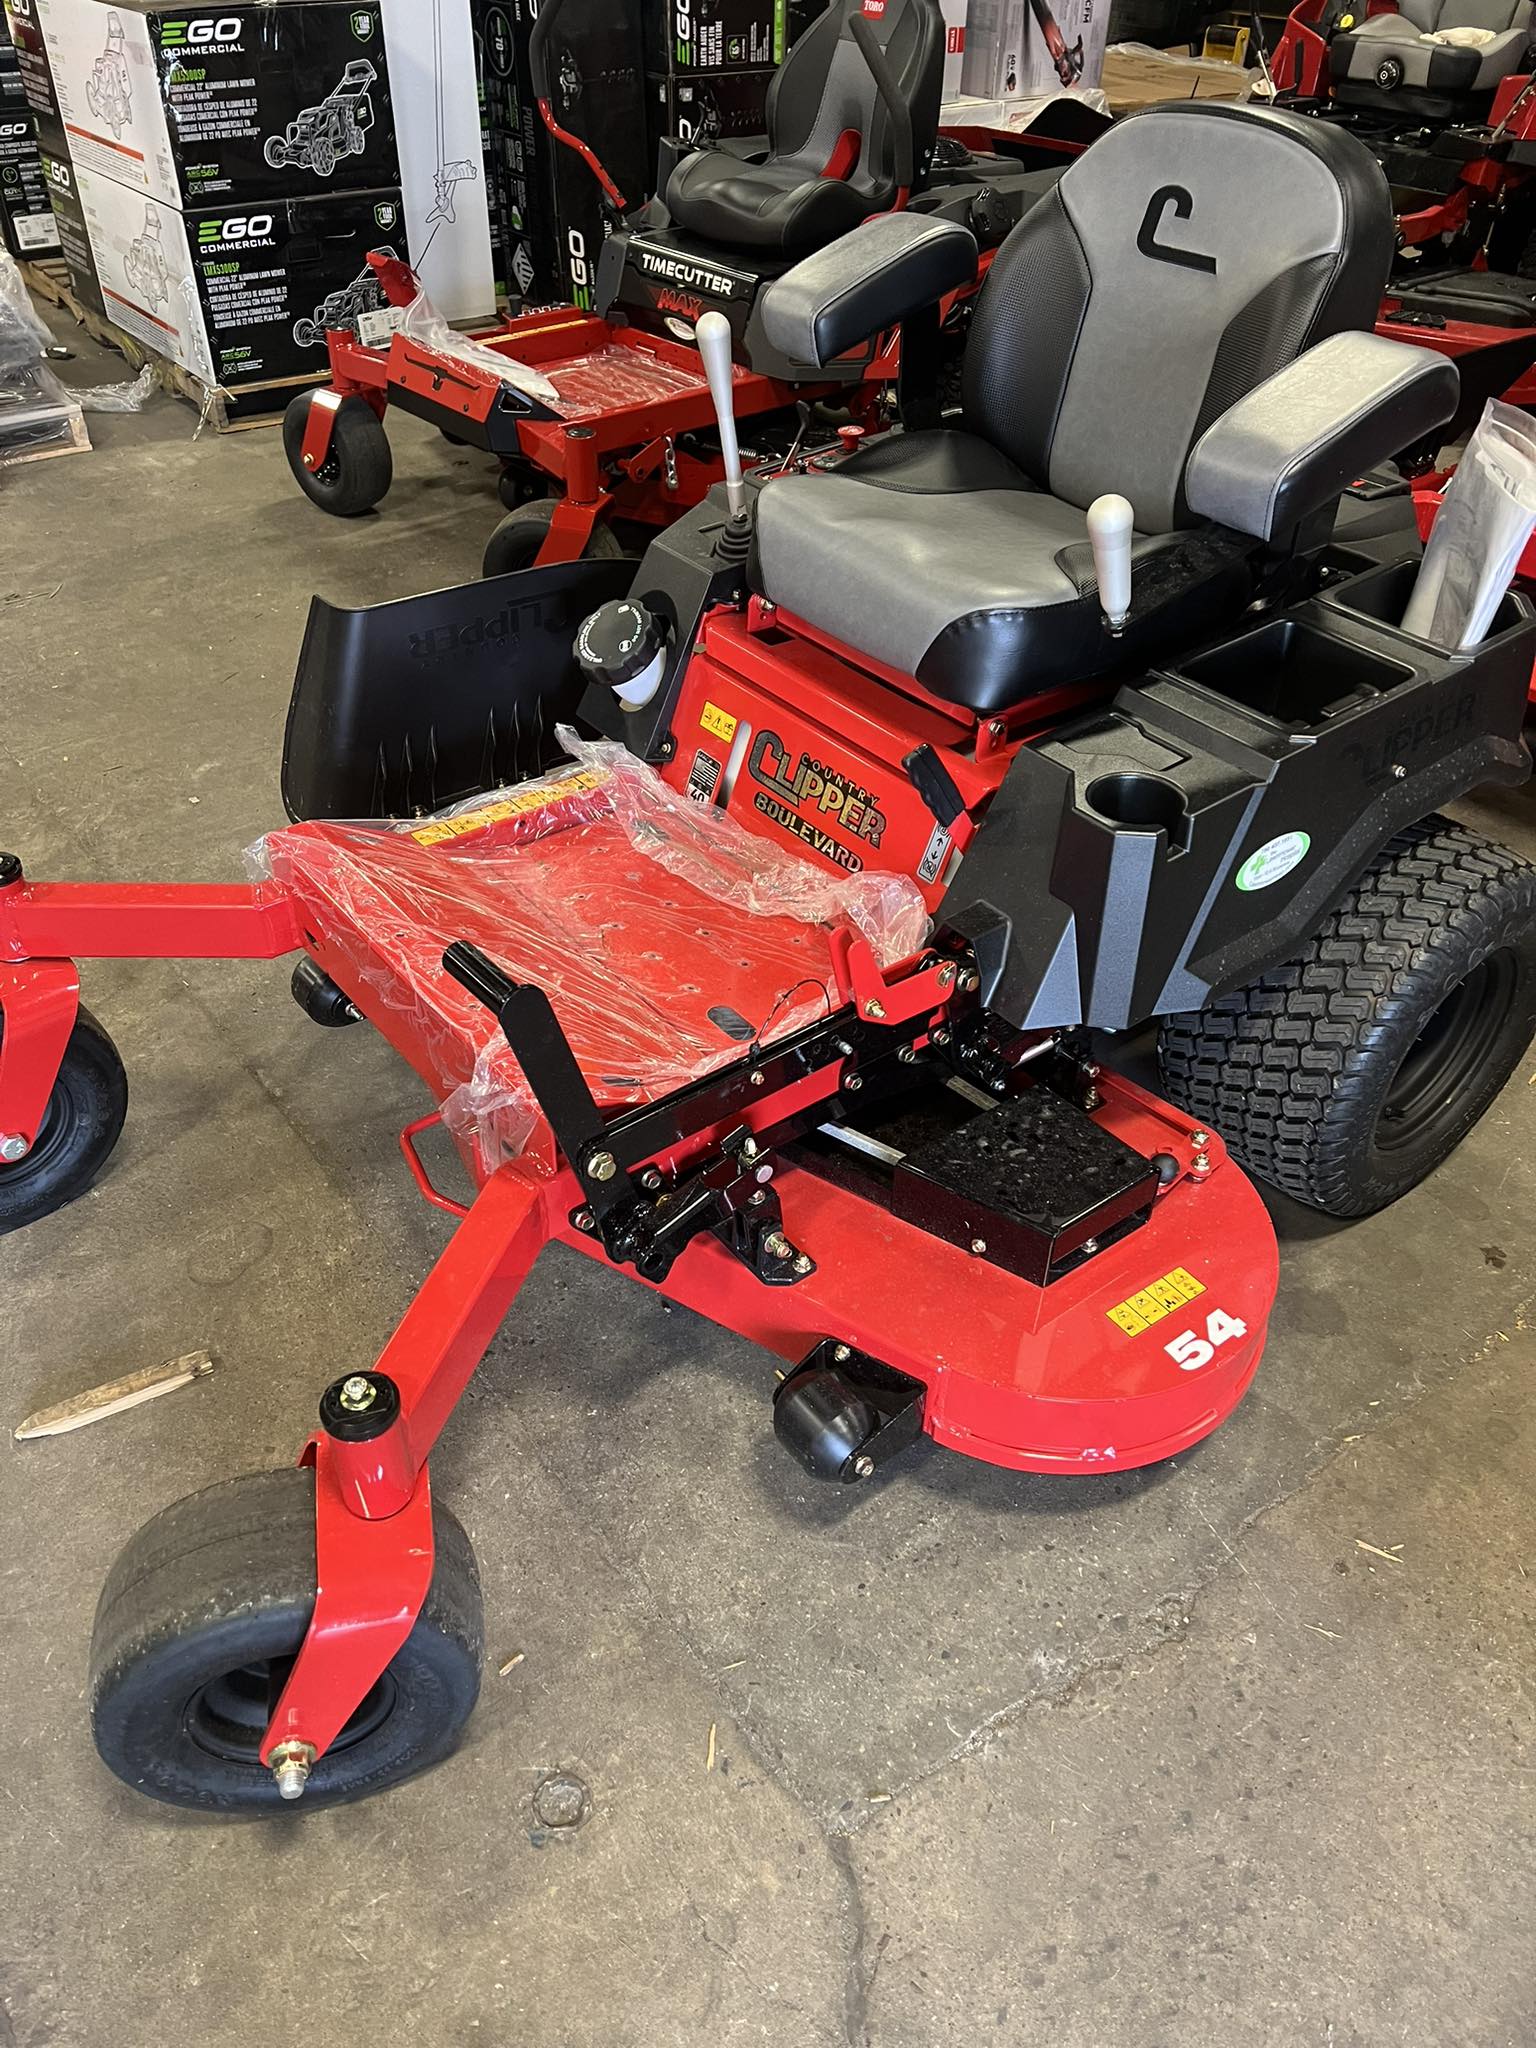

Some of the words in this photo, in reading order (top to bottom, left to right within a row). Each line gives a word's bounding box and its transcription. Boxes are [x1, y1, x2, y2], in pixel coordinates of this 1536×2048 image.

[864, 0, 884, 12] TORO
[161, 18, 242, 45] EGO
[495, 37, 504, 51] 70
[700, 26, 708, 46] AUGER
[700, 46, 708, 66] EARTH
[523, 106, 536, 157] POWER
[42, 156, 70, 187] EGO
[198, 215, 272, 243] EGO
[200, 238, 276, 254] COMMERCIAL
[203, 262, 240, 276] LMX5300SP
[568, 229, 592, 311] EGO
[642, 253, 733, 295] TIMECUTTER
[656, 288, 703, 321] MAX
[748, 729, 887, 849] CLIPPER
[801, 752, 879, 806] COUNTRY
[690, 789, 705, 802] 40
[754, 792, 864, 873] BOULEVARD
[1163, 1308, 1248, 1371] 54
